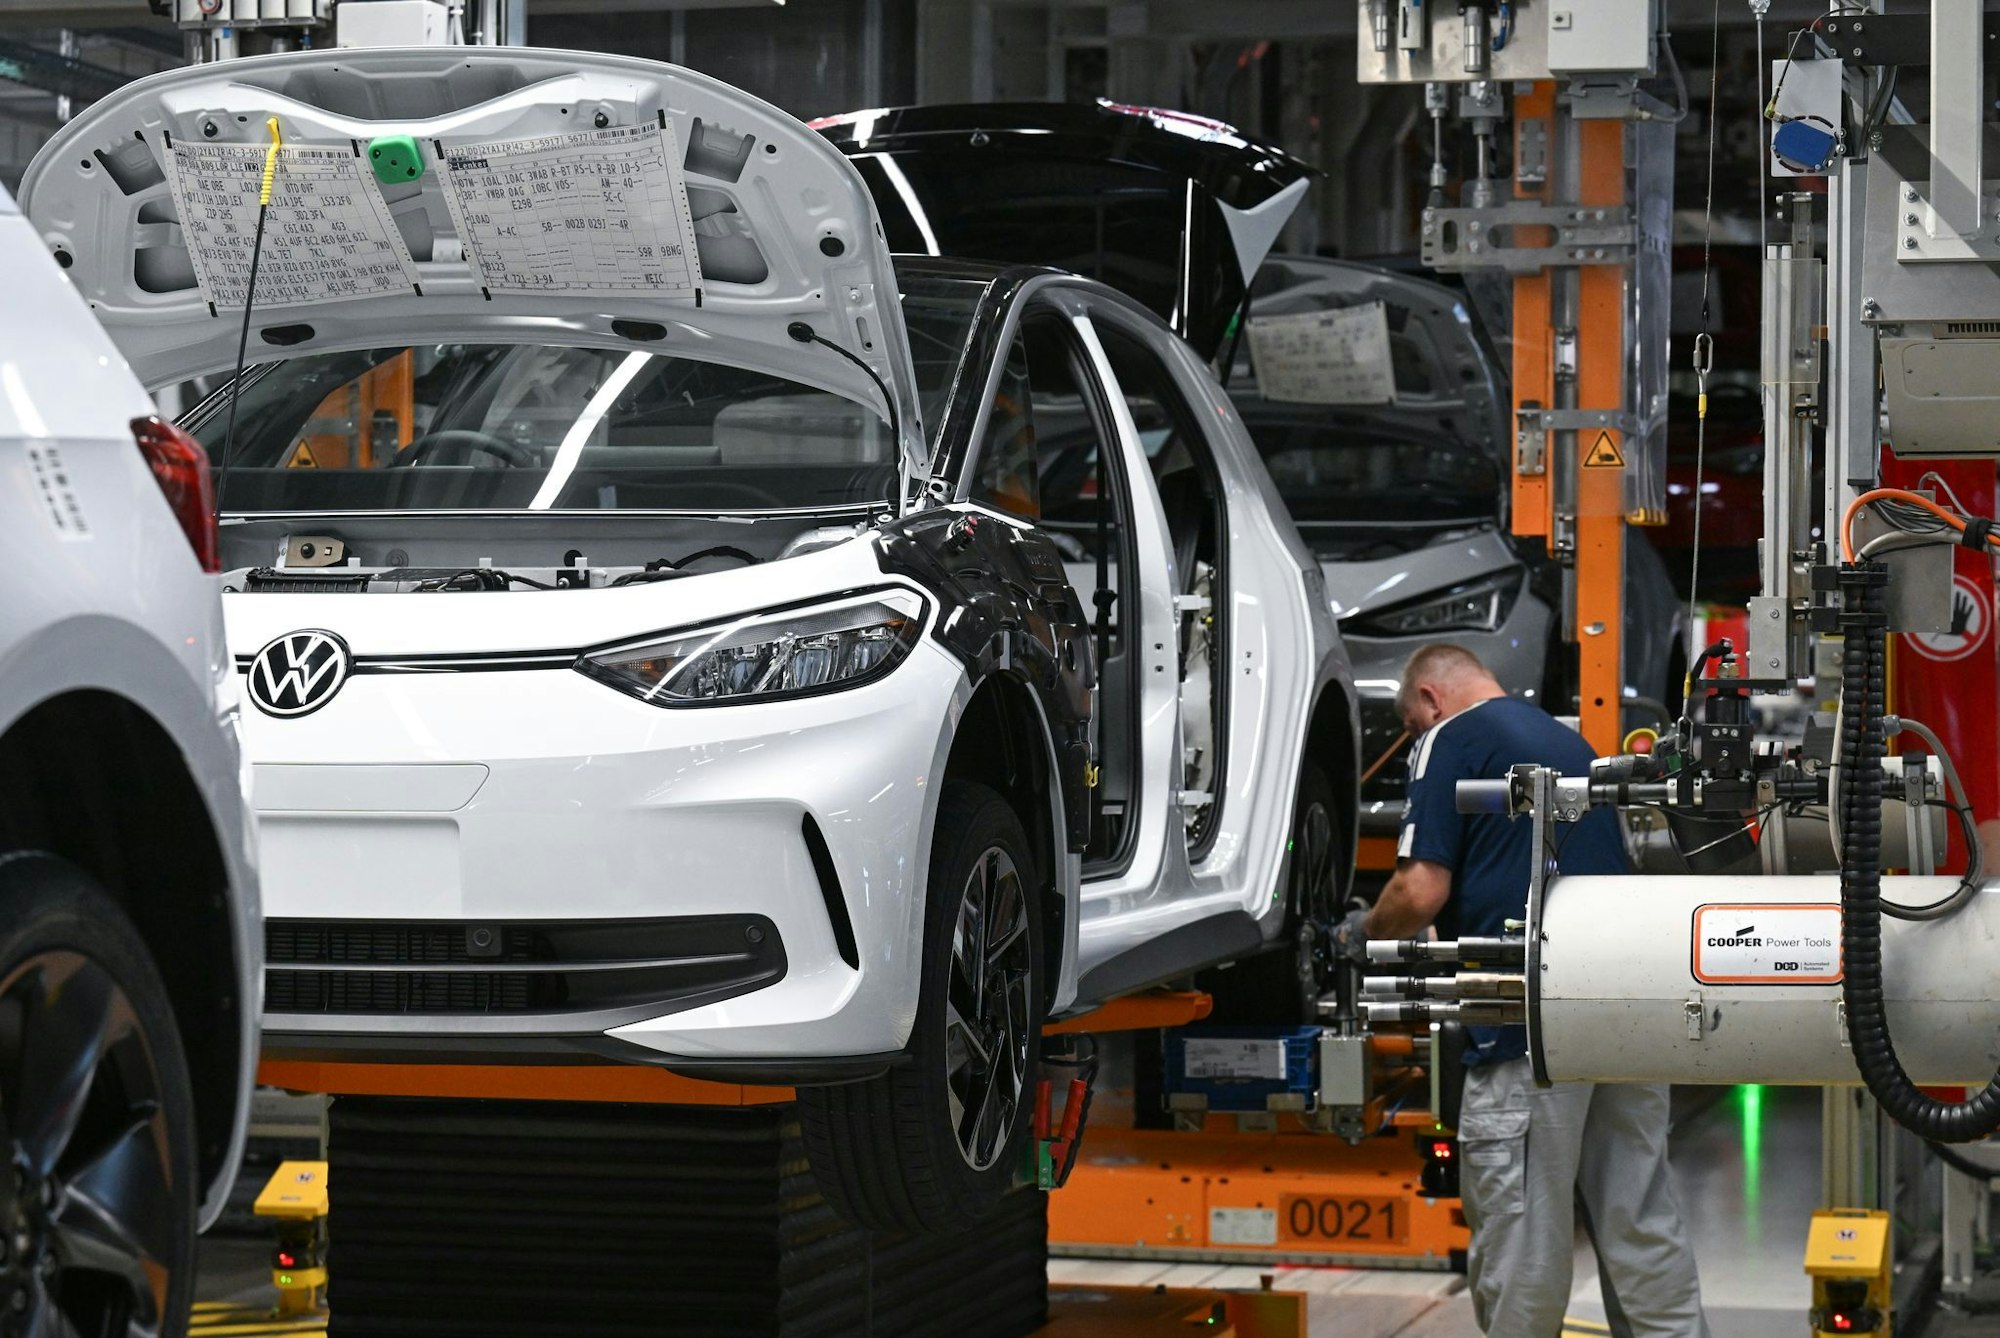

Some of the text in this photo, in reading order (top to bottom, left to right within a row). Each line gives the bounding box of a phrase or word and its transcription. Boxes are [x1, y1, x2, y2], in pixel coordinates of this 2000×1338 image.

[514, 138, 560, 150] 42-3-5917
[568, 133, 588, 142] 5677
[449, 161, 487, 169] R-Lenker
[482, 175, 502, 186] 10AL
[505, 173, 524, 184] 10AC
[551, 166, 570, 177] R-BT
[574, 164, 594, 174] RS-L
[290, 197, 304, 206] 1PE
[498, 227, 517, 236] A-4C
[1708, 938, 1831, 947] COOPER Power Tools
[1289, 1198, 1395, 1238] 0021
